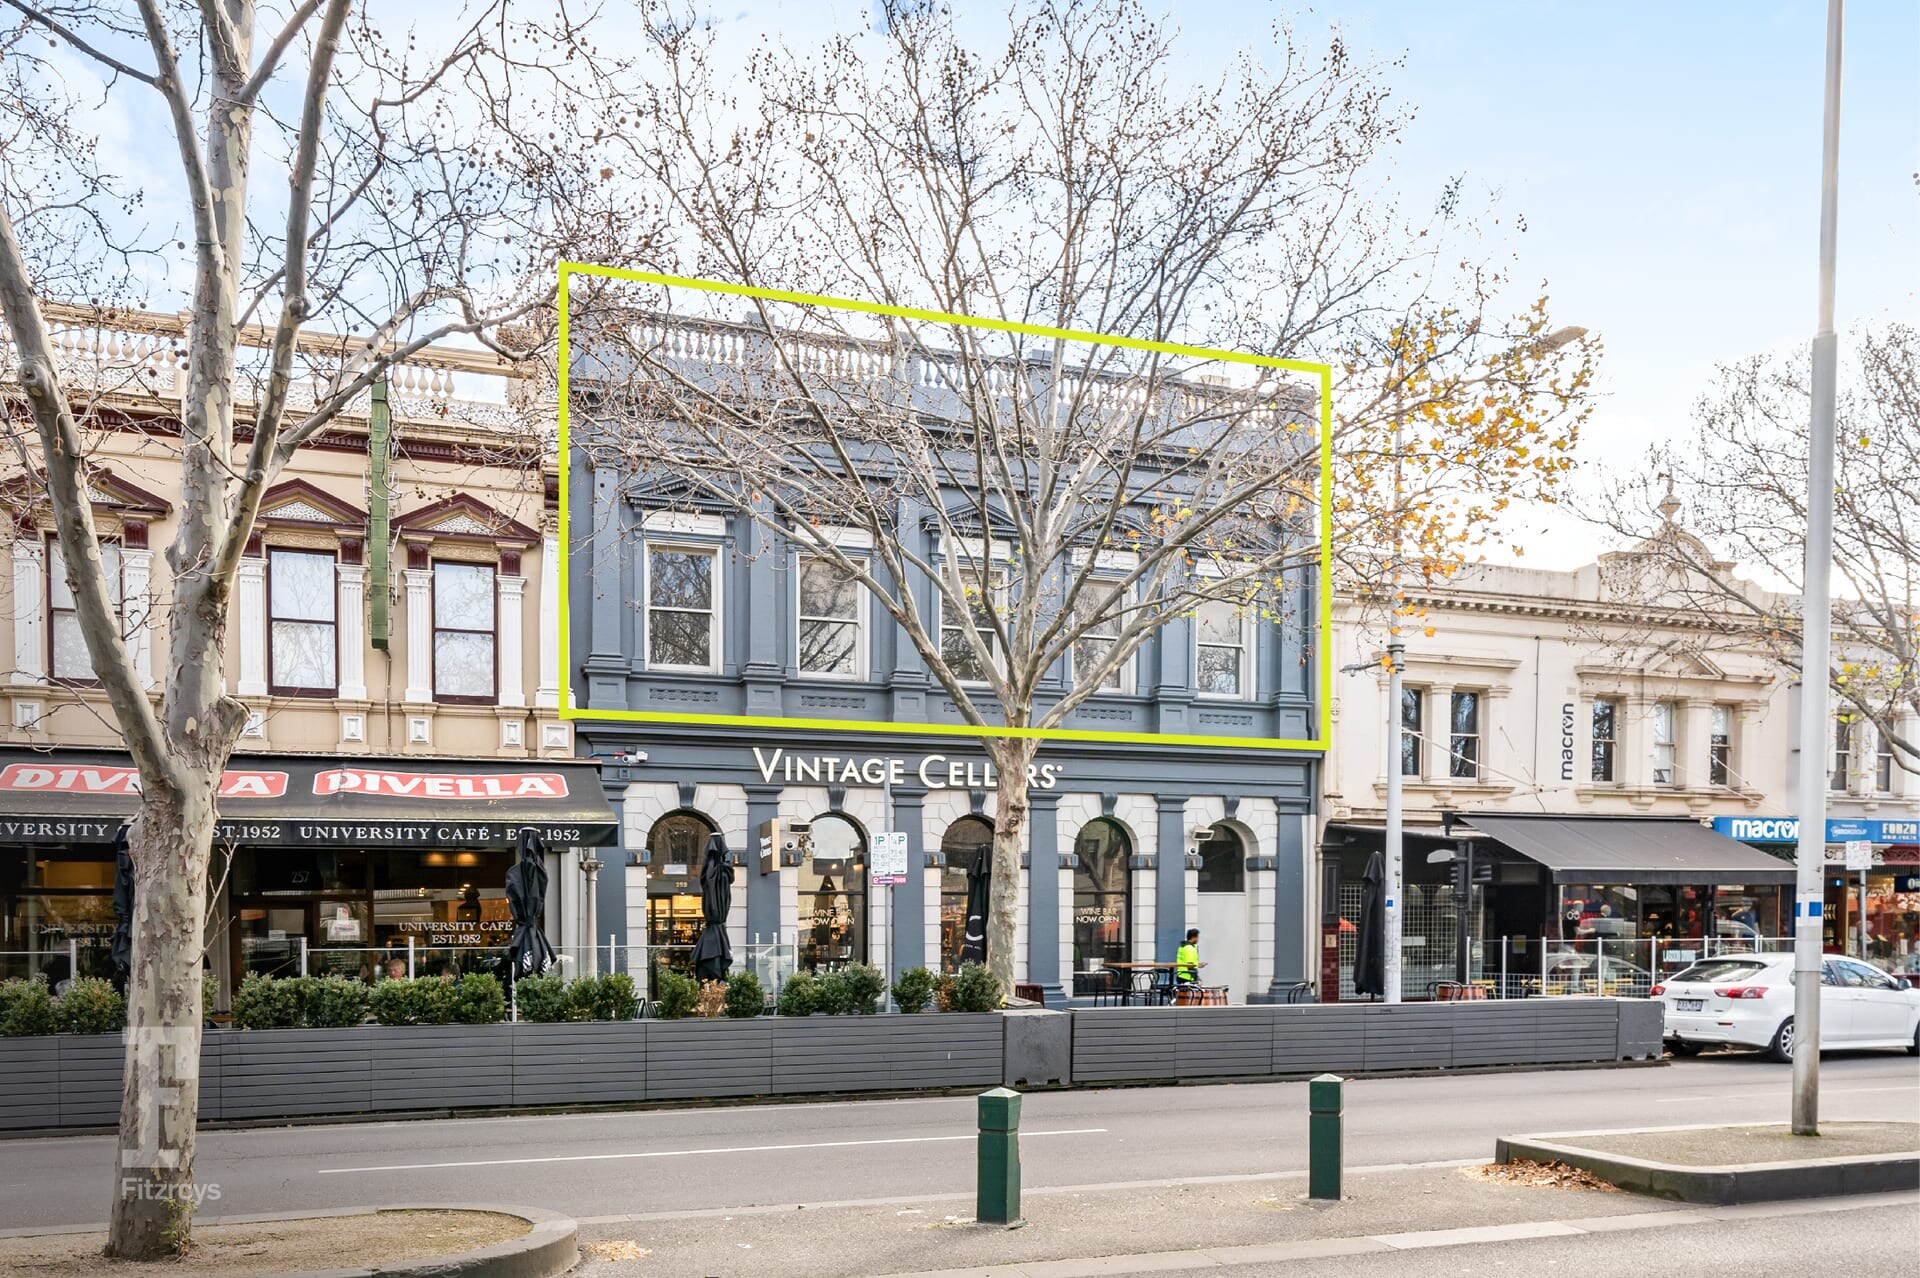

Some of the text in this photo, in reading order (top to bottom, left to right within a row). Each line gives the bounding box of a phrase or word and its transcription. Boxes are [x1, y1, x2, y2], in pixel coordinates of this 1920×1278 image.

[1561, 703, 1574, 780] macron
[753, 747, 1056, 788] VINTAGE CELLRS
[327, 772, 556, 796] DIVELLA
[213, 825, 280, 838] ST.1952
[300, 826, 431, 840] UNIVERSITY
[437, 827, 490, 840] CAFÉ
[506, 829, 580, 841] E.1952
[399, 920, 513, 931] UNIVERSITY CAFÉ
